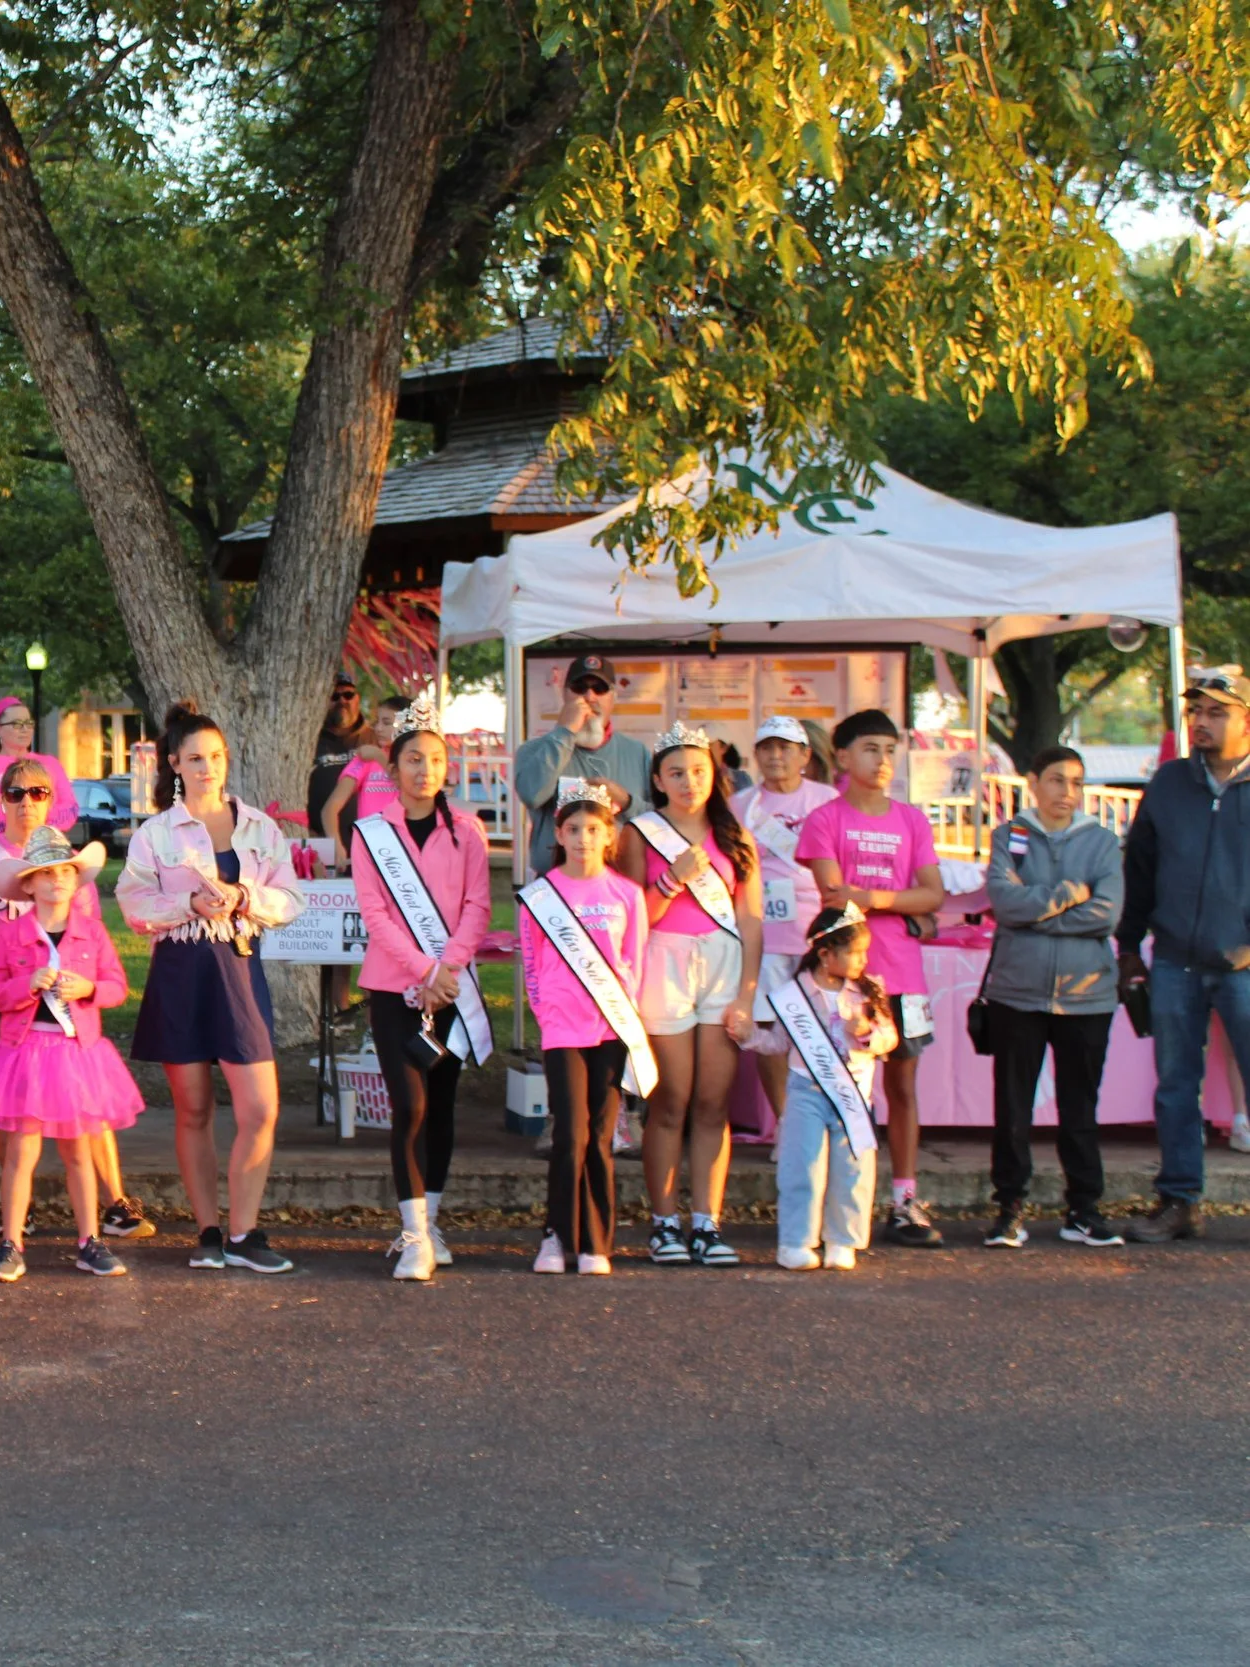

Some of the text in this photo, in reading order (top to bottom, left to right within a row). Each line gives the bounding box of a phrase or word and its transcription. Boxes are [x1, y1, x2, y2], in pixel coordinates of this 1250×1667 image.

[378, 848, 402, 878] Miss
[274, 930, 334, 939] PROBATION
[278, 941, 329, 951] BUILDING
[548, 916, 581, 953] Miss
[786, 1003, 812, 1040] Miss
